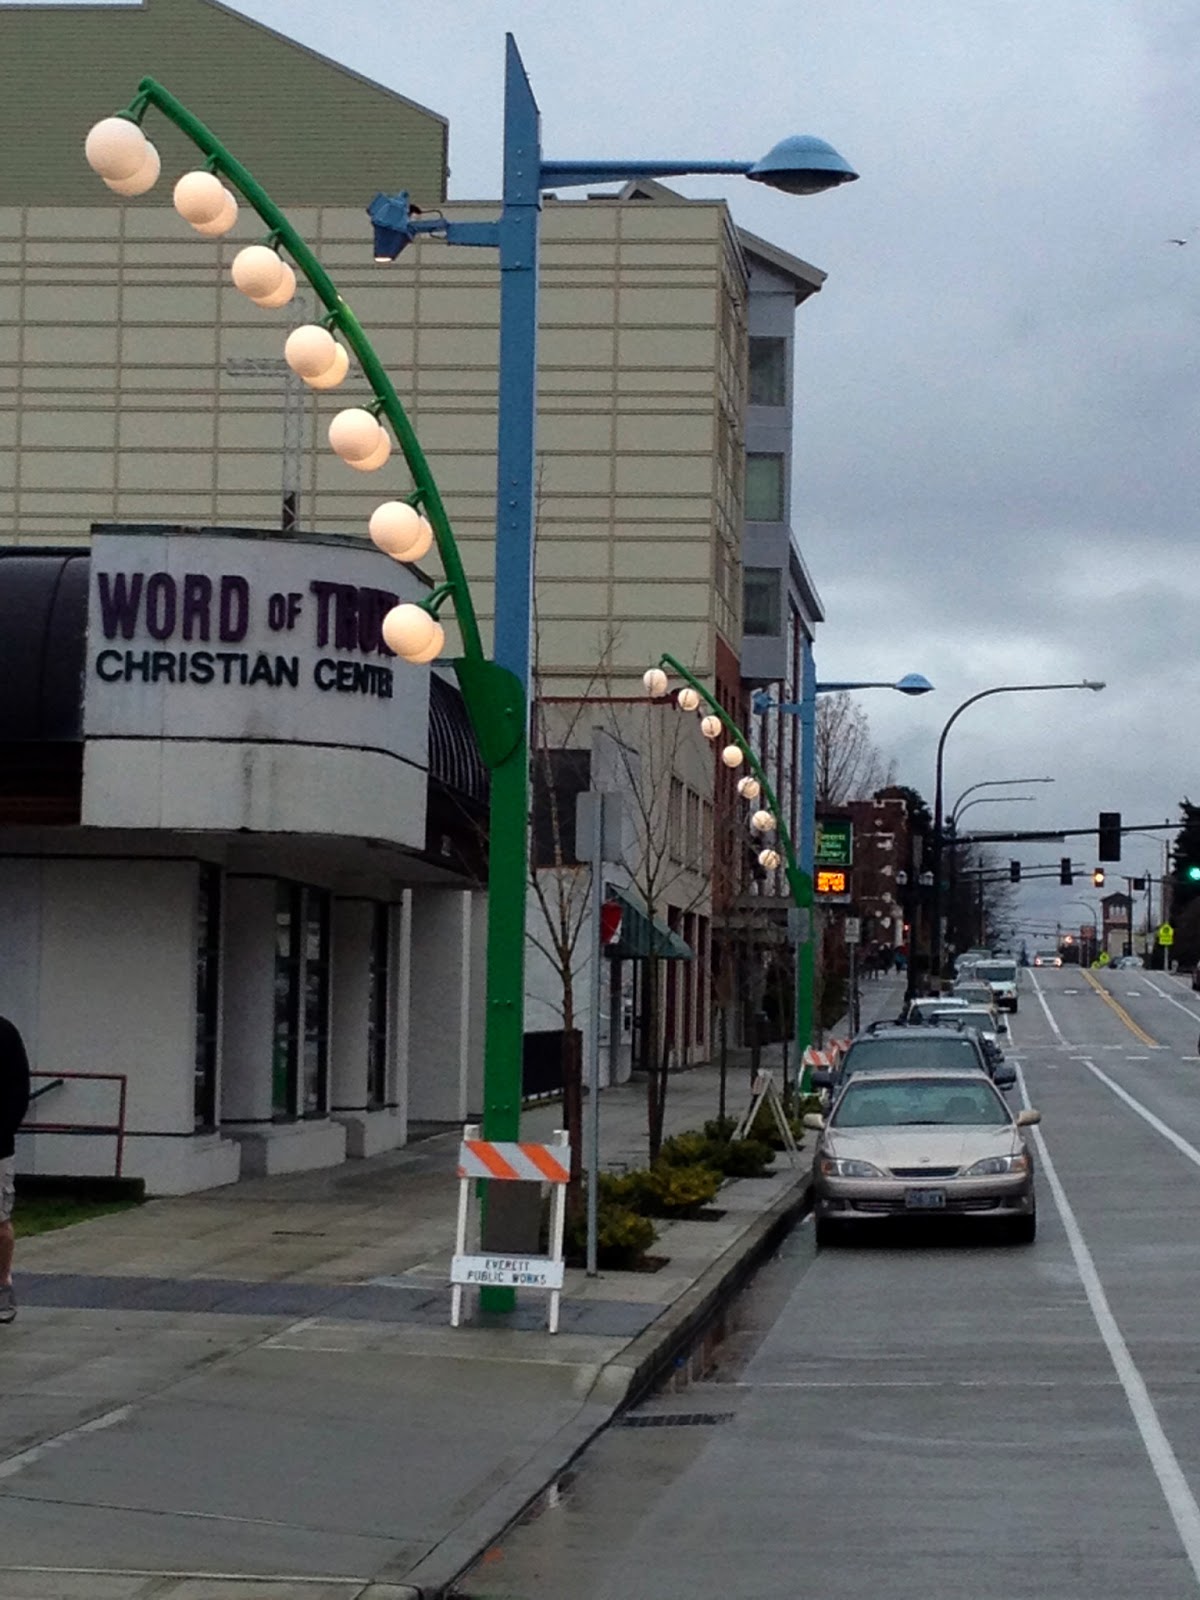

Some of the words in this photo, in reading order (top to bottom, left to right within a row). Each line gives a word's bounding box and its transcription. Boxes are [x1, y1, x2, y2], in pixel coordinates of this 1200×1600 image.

[97, 572, 250, 643] WORD
[268, 592, 303, 632] OF
[310, 580, 401, 658] TRU
[96, 649, 299, 688] CHRISTIAN
[313, 657, 394, 699] CENTER
[467, 1270, 504, 1283] PUBLIC
[512, 1273, 547, 1286] WORKS
[485, 1259, 530, 1272] EVERETT
